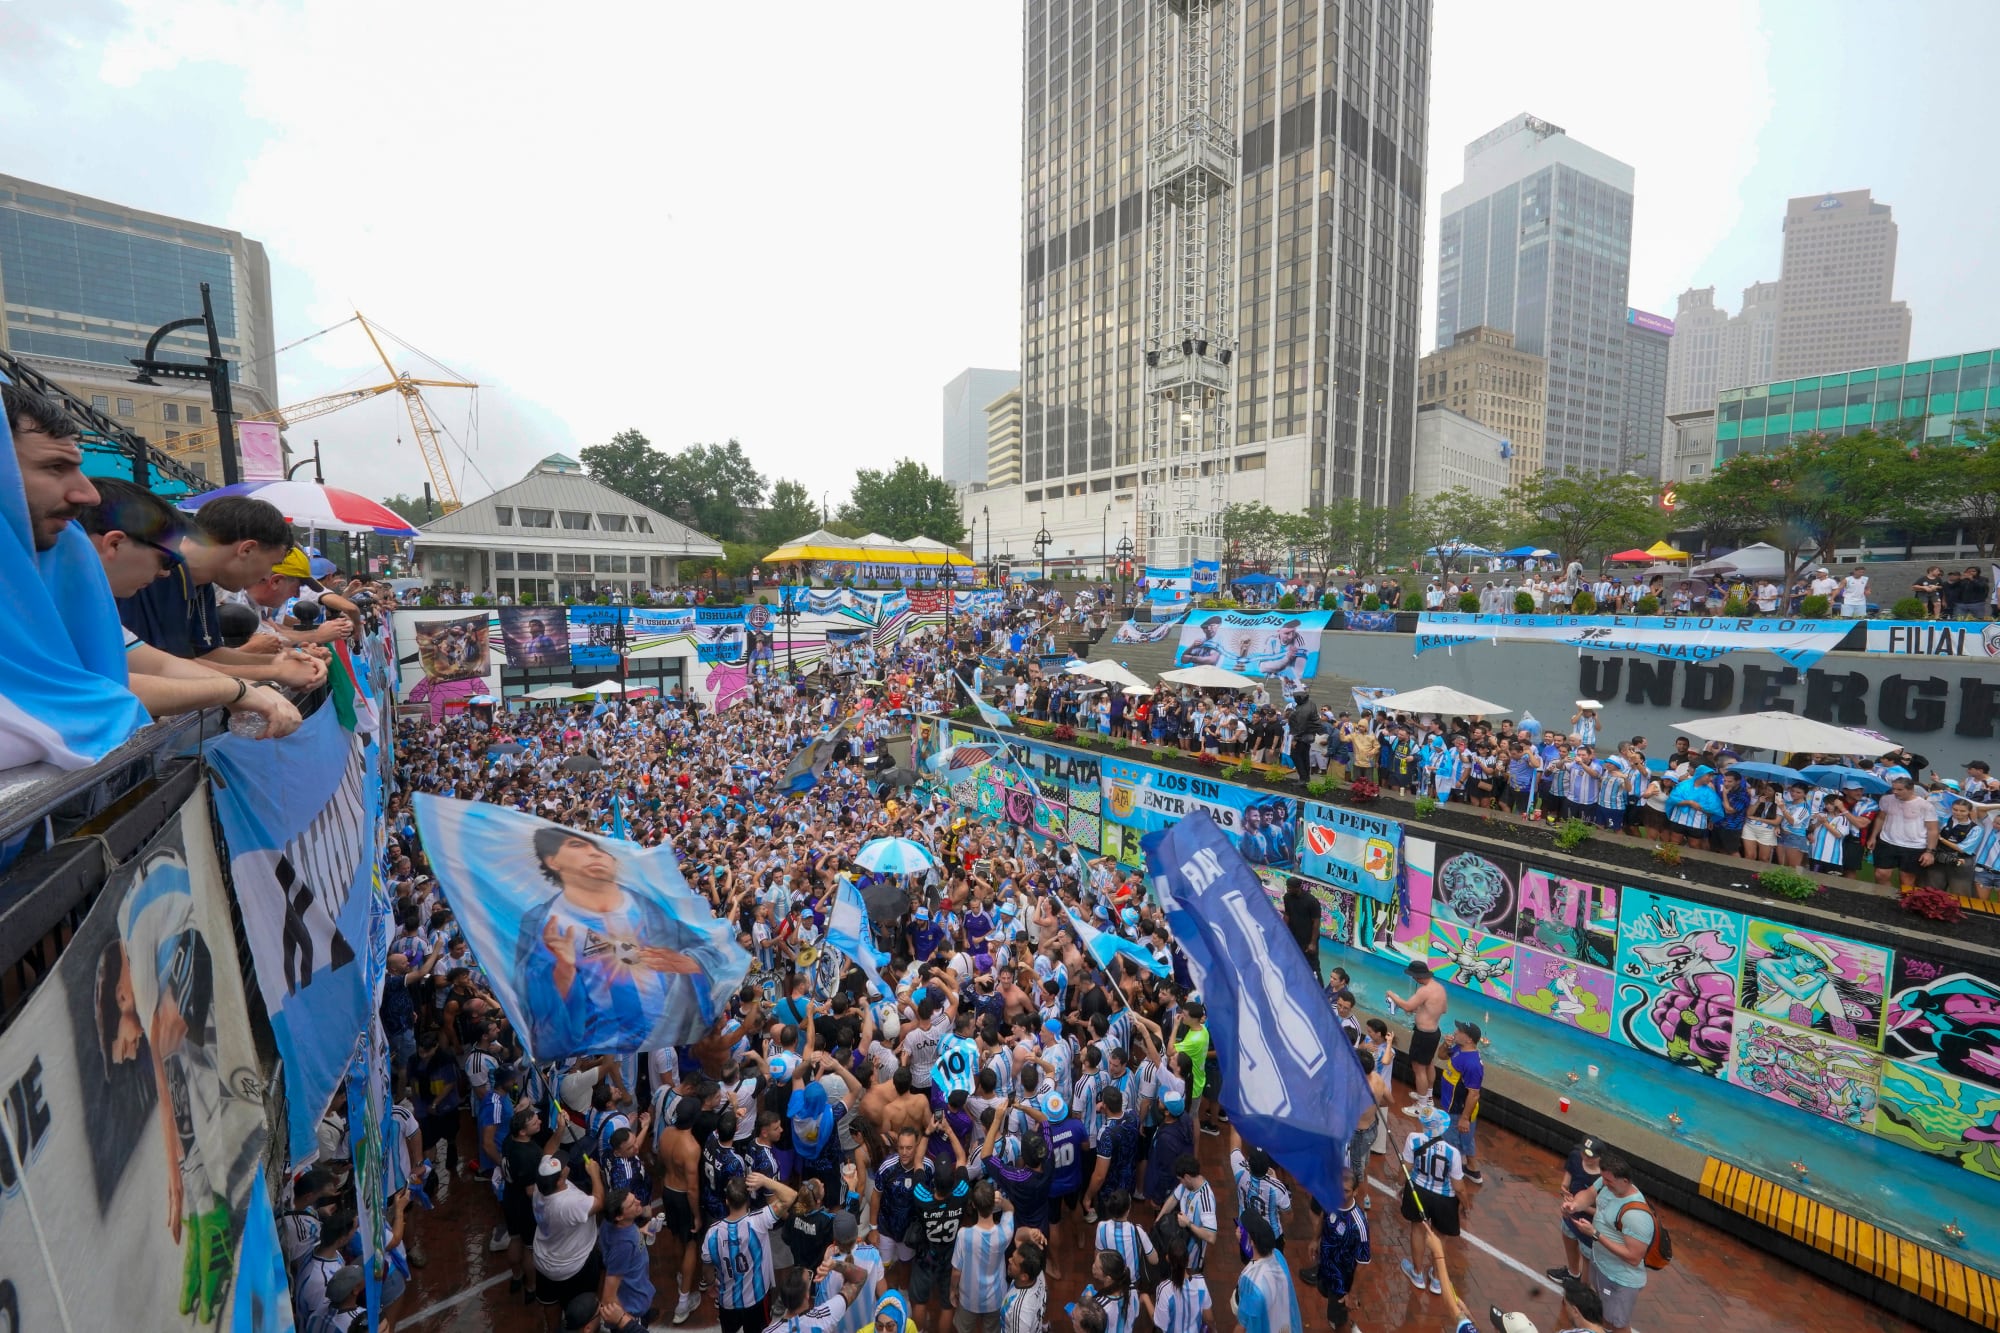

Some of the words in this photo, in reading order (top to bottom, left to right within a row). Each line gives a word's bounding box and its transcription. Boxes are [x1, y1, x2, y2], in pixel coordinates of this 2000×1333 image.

[875, 565, 901, 580] BANDA
[915, 567, 932, 580] NEW
[700, 611, 743, 620] USHUAIA
[1224, 614, 1285, 627] SIMBIOSIS
[1555, 614, 1578, 626] de
[1044, 753, 1102, 786] PLATA
[1157, 772, 1188, 791] LOS
[1190, 781, 1221, 800] SIN
[1316, 806, 1335, 823] LA
[1339, 812, 1387, 837] PEPSI
[1325, 861, 1358, 884] EMA
[1667, 904, 1736, 938] RATA
[937, 1051, 966, 1081] 10
[1053, 1142, 1075, 1169] 10
[1418, 1150, 1450, 1183] 10
[925, 1218, 960, 1243] 23
[723, 1252, 750, 1279] 10
